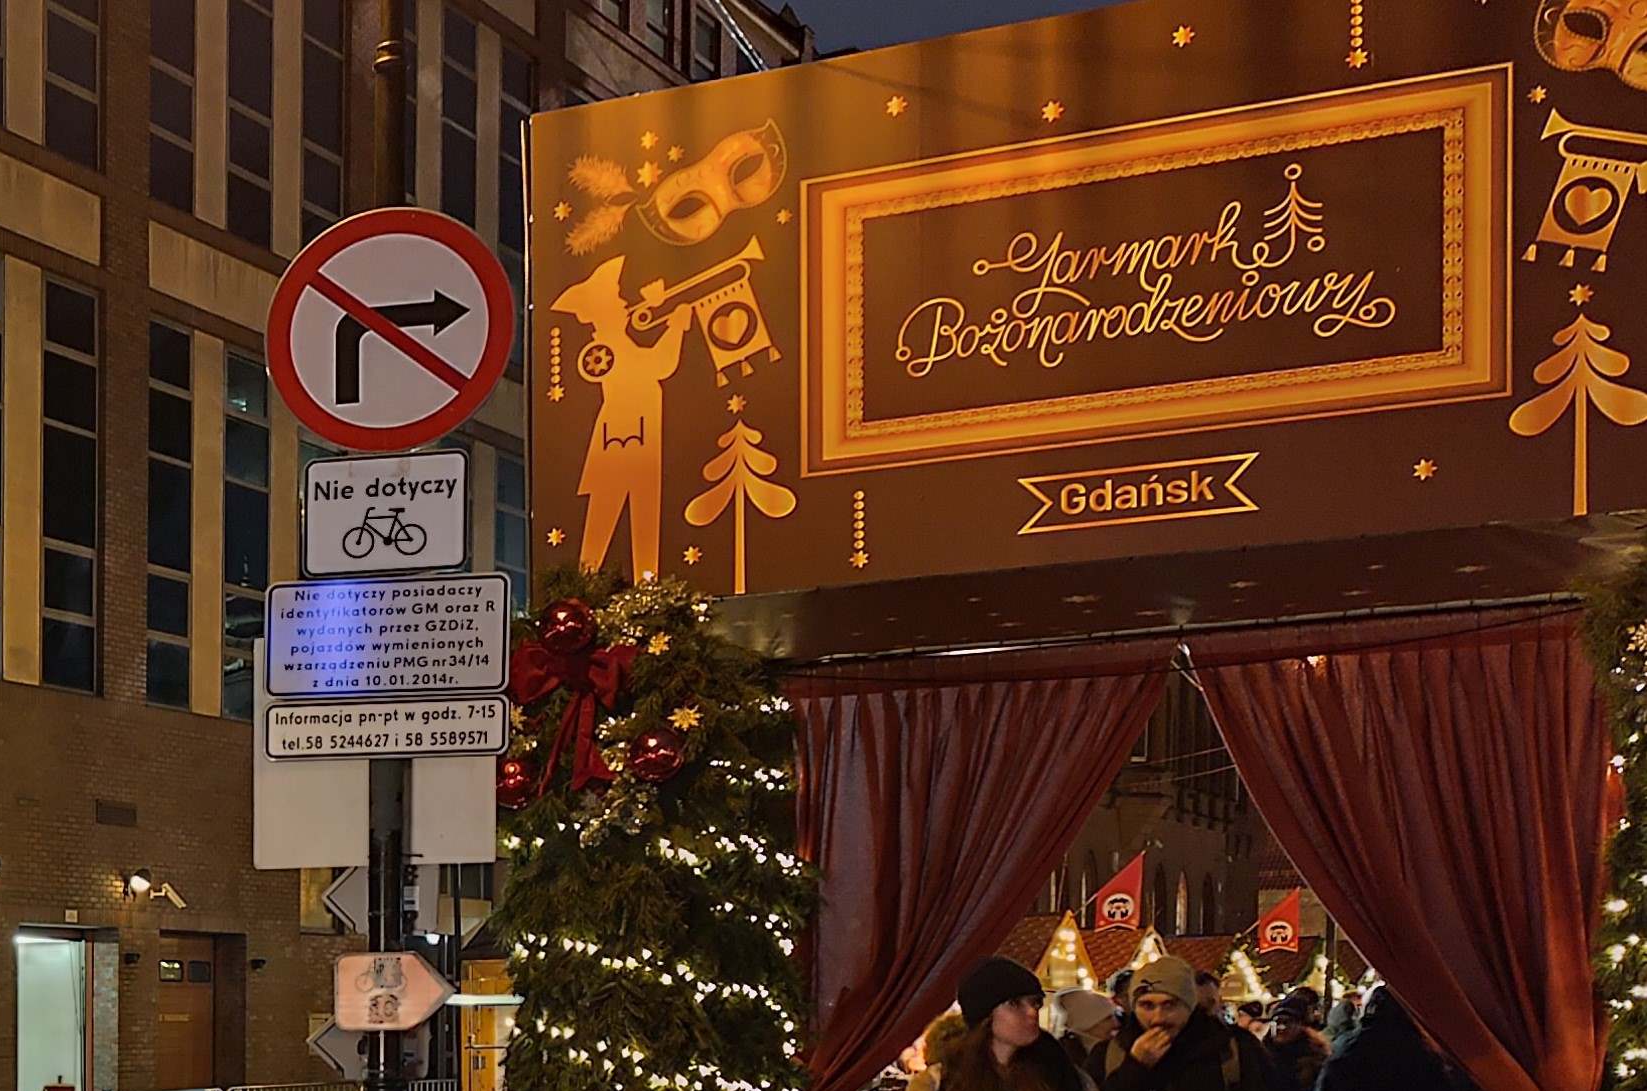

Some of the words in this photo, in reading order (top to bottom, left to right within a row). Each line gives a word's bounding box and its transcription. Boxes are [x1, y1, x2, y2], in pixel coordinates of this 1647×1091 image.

[896, 271, 1395, 377] Bożonarodzeniowy
[314, 480, 354, 501] Nie
[365, 477, 457, 501] dotyczy
[1061, 470, 1216, 516] Gdańsk
[295, 590, 320, 601] Nie
[327, 589, 385, 602] dotyczy
[392, 585, 482, 601] posiadaczy
[280, 603, 406, 620] identyfikatorów
[412, 602, 438, 615] GM
[445, 603, 479, 613] oraz
[486, 600, 495, 612] R
[297, 624, 372, 638] wydanych
[379, 623, 419, 637] przez
[290, 640, 365, 656] pojazdów
[372, 636, 484, 654] wymienionych
[394, 656, 428, 668] PMG
[325, 676, 359, 688] dnia
[275, 710, 352, 727] Informacja
[359, 708, 398, 727] pn-pt
[404, 711, 415, 721] w
[422, 706, 461, 725] godz.
[467, 704, 496, 719] 7-15
[330, 734, 389, 749] 5244627
[395, 733, 399, 747] i
[405, 732, 423, 746] 58
[430, 730, 488, 746] 5589571
